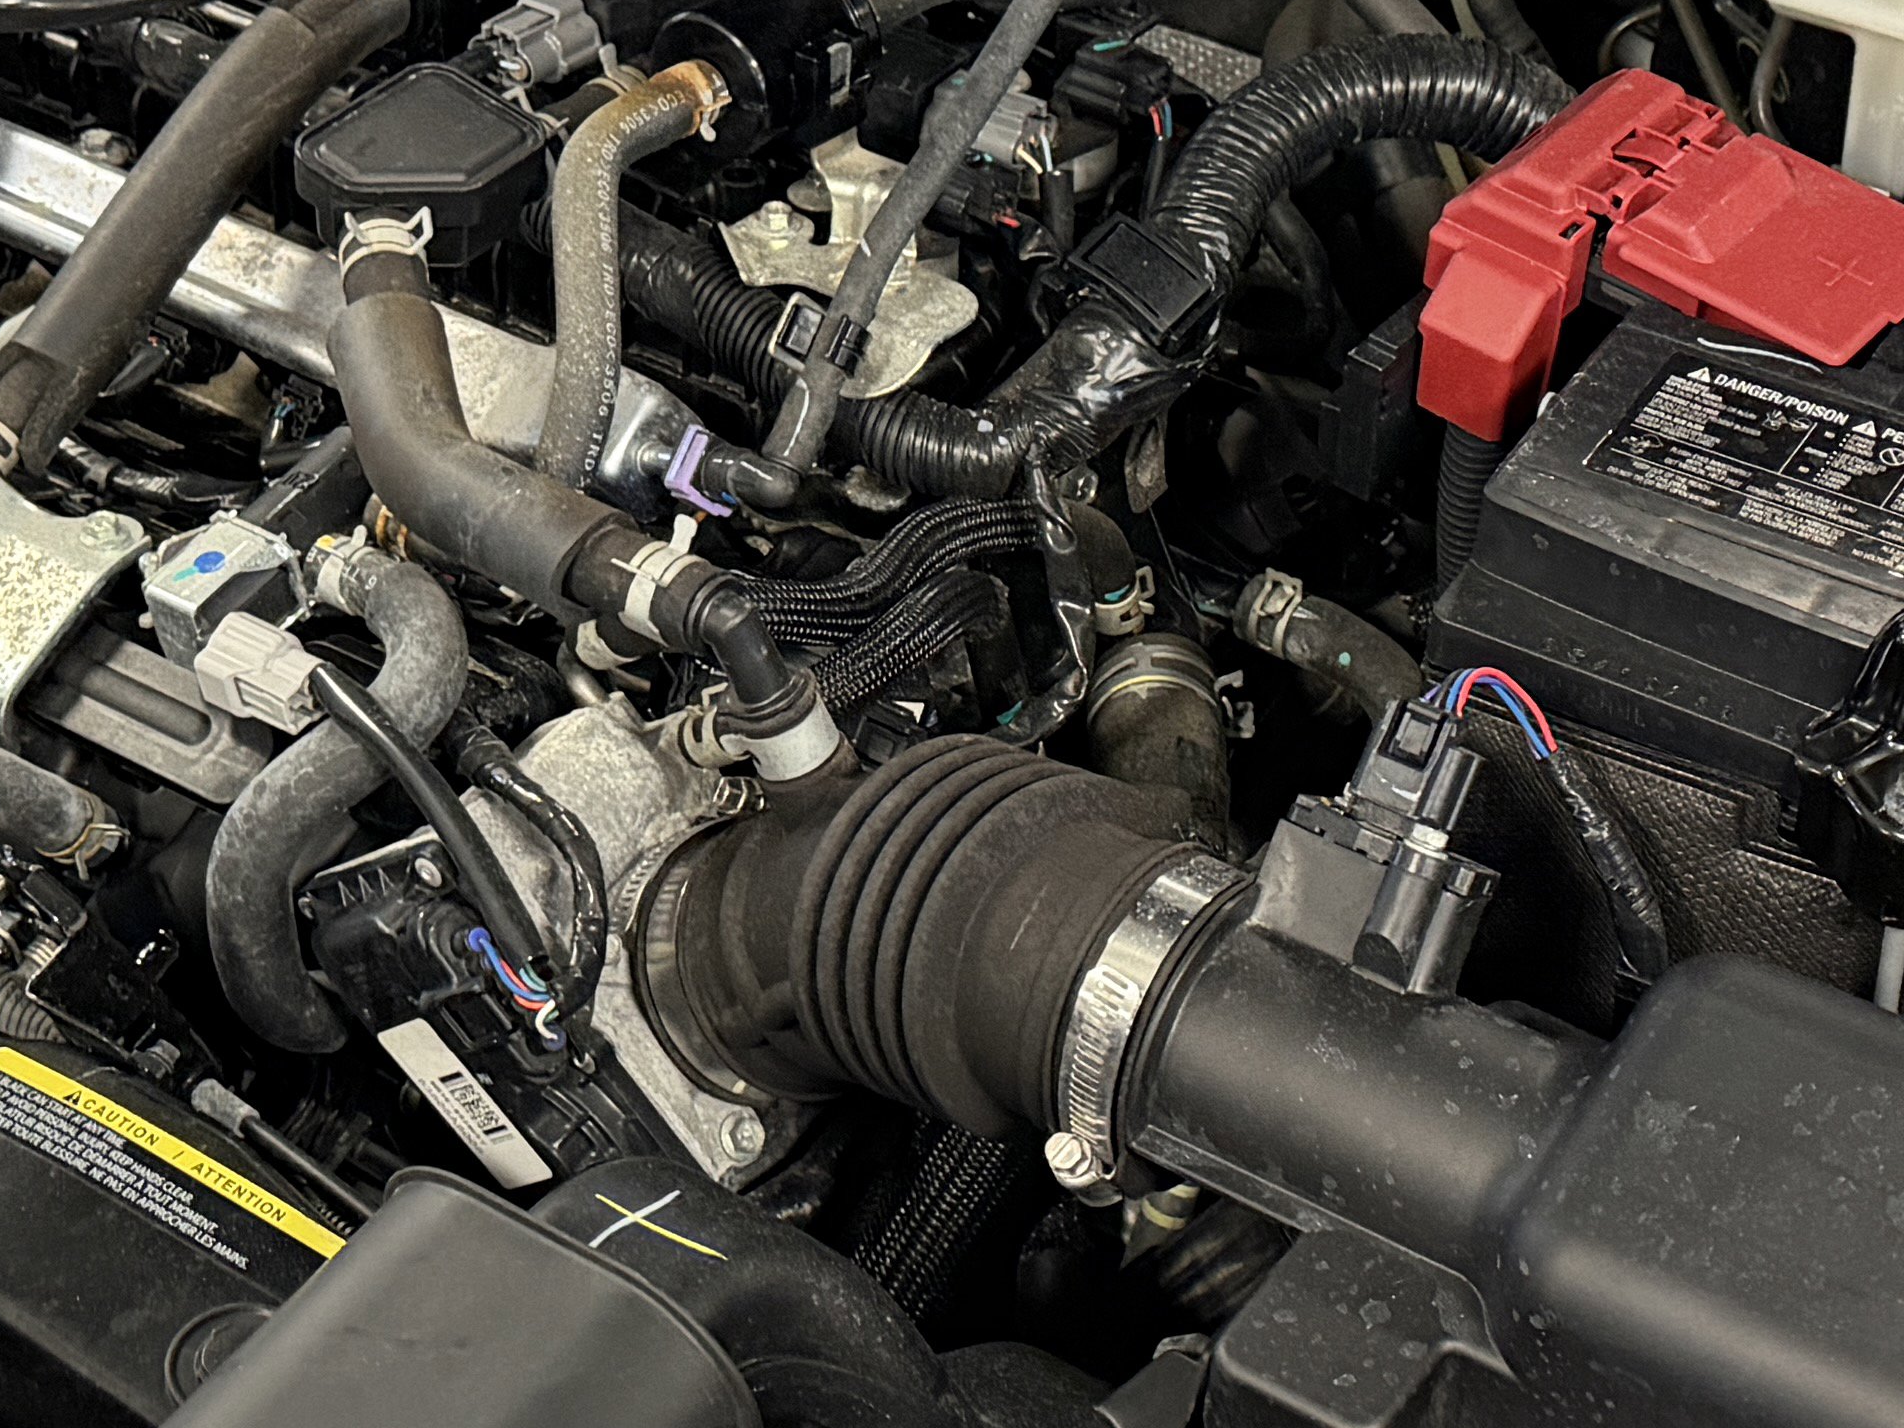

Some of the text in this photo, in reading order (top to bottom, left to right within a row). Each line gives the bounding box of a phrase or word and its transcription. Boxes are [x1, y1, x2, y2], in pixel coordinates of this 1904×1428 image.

[1712, 373, 1851, 425] DANGER/POISON
[80, 1097, 160, 1147] CAUTION
[189, 1159, 287, 1222] ATTENTION
